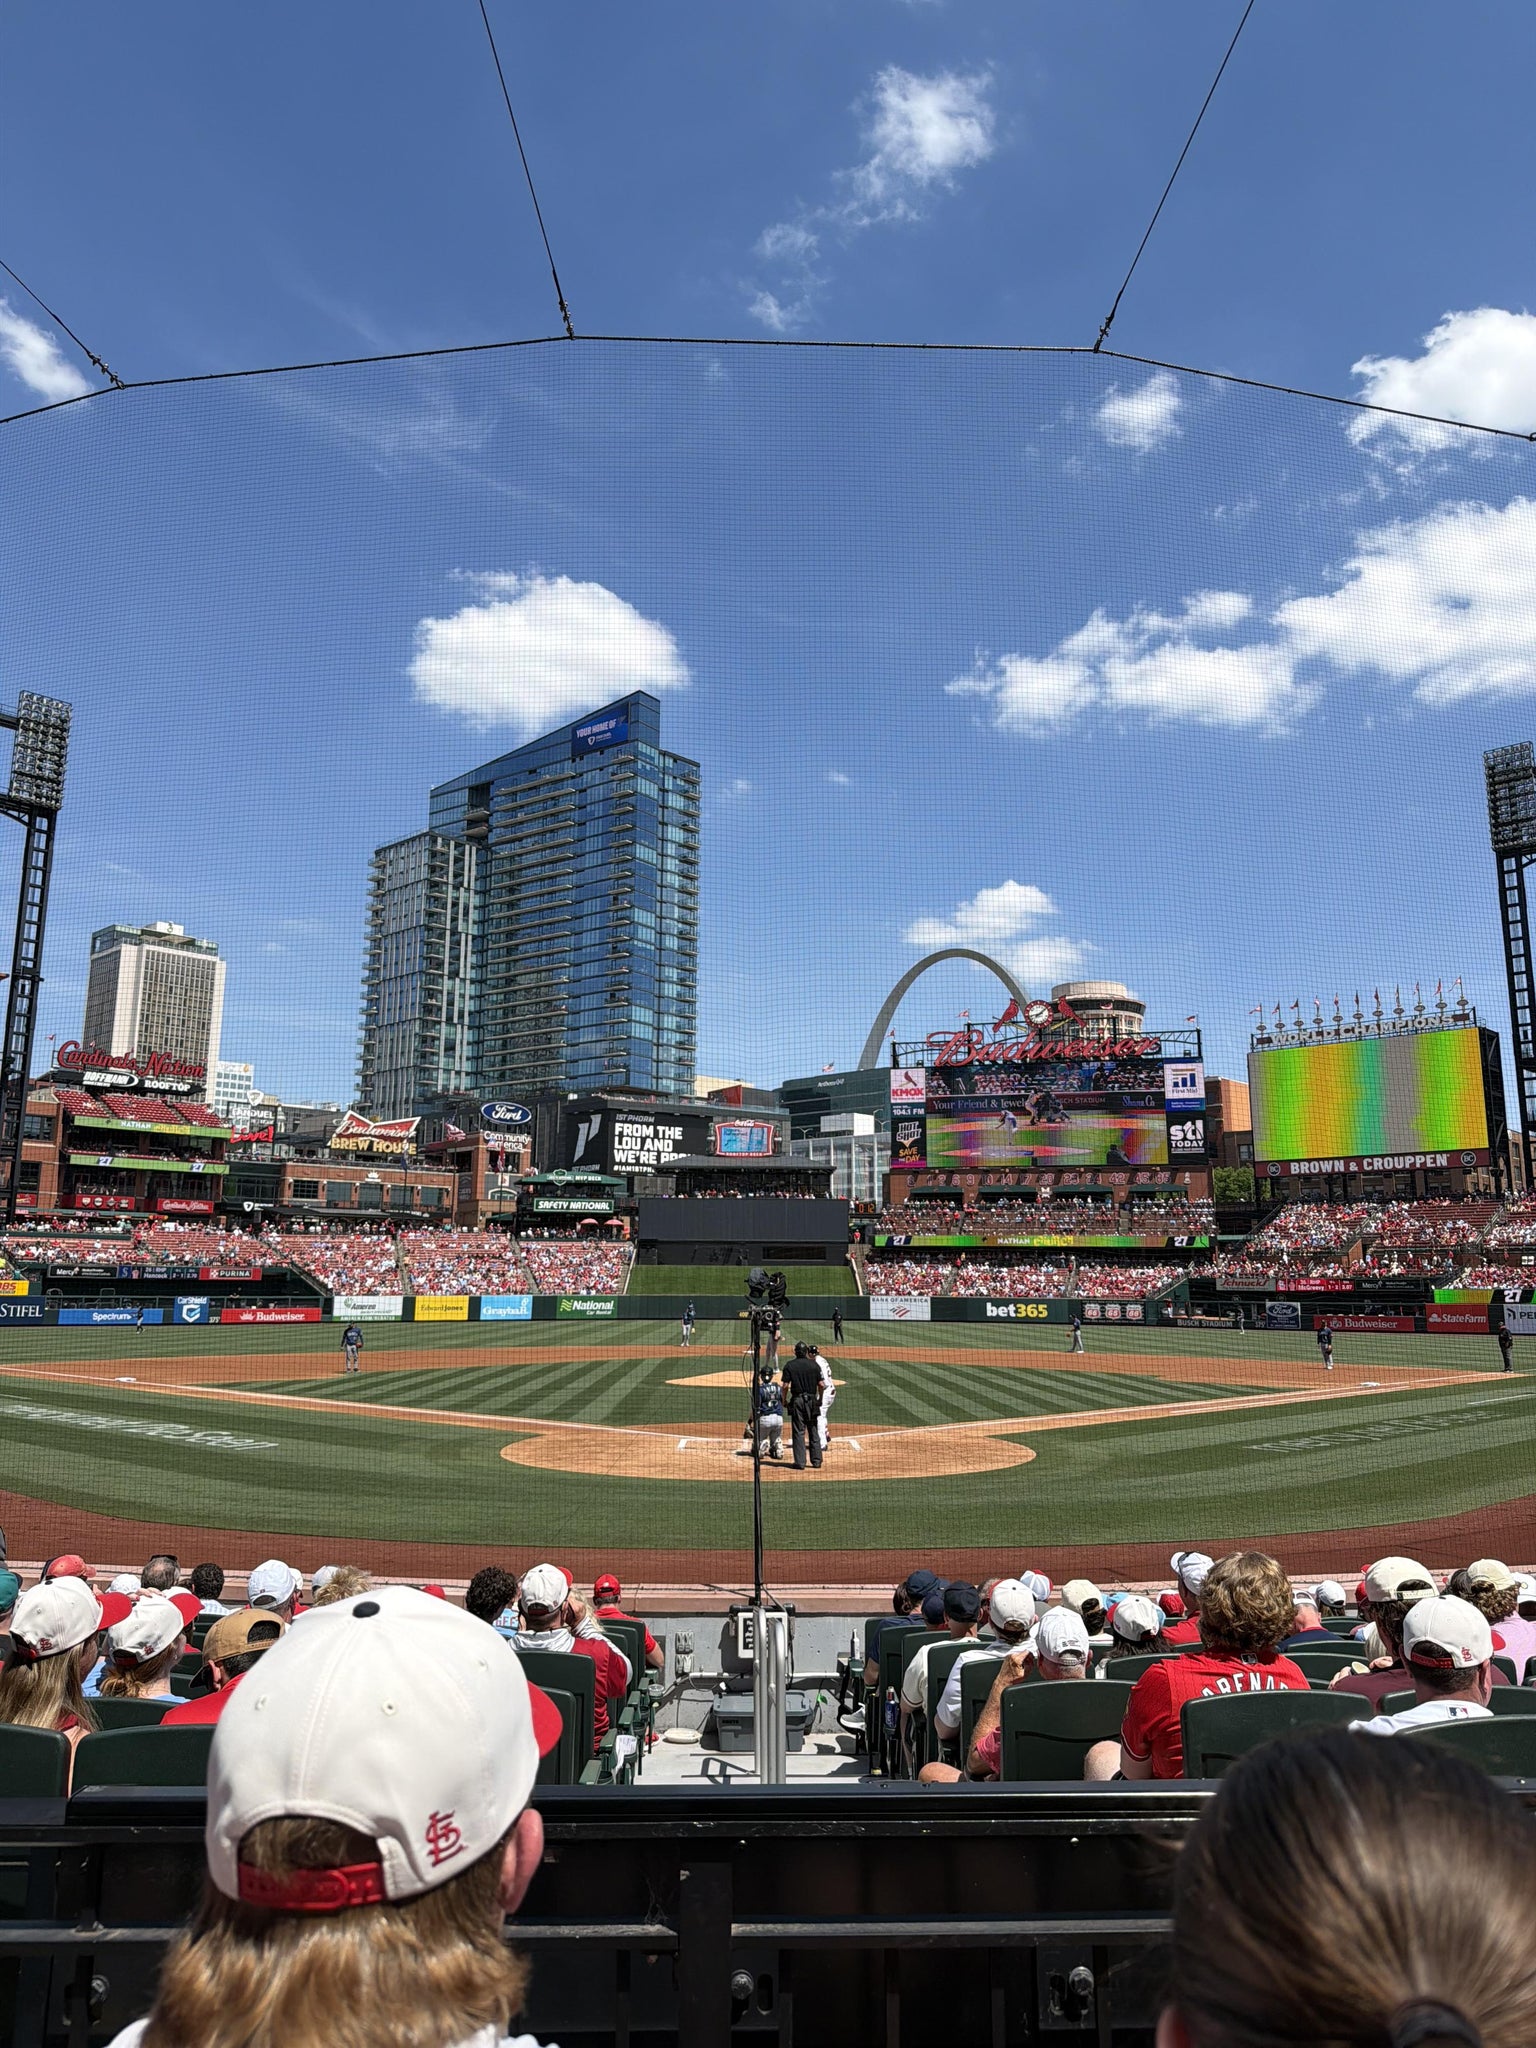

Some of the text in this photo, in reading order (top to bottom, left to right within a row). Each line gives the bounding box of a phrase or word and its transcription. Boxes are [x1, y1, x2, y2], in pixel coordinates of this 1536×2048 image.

[576, 727, 591, 738] YOUR
[1269, 1015, 1454, 1045] WORLD CHAMPIONS
[925, 1029, 1161, 1067] Budweiser
[57, 1040, 204, 1078] Cardinals Nation
[83, 1071, 130, 1085] HOFFMANN
[144, 1080, 191, 1092] ROOFTOP
[892, 1087, 924, 1097] KMOX
[933, 1101, 957, 1111] Your
[957, 1100, 989, 1109] Friend
[990, 1099, 998, 1109] &
[492, 1104, 522, 1120] Ford
[627, 1114, 655, 1123] PHORM
[121, 1120, 151, 1129] NATHAN
[332, 1118, 417, 1138] Budweiser
[898, 1121, 919, 1132] HOT
[1170, 1120, 1204, 1140] stl
[229, 1125, 275, 1144] Live!
[615, 1122, 683, 1140] FROM THE
[896, 1129, 922, 1141] SHOT
[331, 1137, 371, 1151] BREW
[614, 1136, 673, 1152] LOU AND
[614, 1149, 657, 1164] WE'RE
[899, 1147, 918, 1157] SAVE
[99, 1156, 113, 1166] 27
[905, 1154, 920, 1163] DAY
[1290, 1160, 1345, 1174] BROWN
[1349, 1161, 1359, 1172] &
[1363, 1154, 1448, 1171] CROUPPEN
[192, 1163, 205, 1172] 27
[966, 1174, 975, 1185] 9
[1000, 1173, 1013, 1185] 14
[1063, 1173, 1080, 1185] 23
[1109, 1172, 1126, 1185] 42
[1135, 1172, 1151, 1184] 45
[538, 1201, 610, 1210] SAFETY NATIONAL
[892, 1236, 906, 1246] 27
[997, 1237, 1030, 1245] NATHAN
[1174, 1236, 1188, 1246] 27
[56, 1267, 75, 1276] Mercy
[1222, 1278, 1269, 1287] Schnucks
[1362, 1281, 1379, 1289] Mercy
[177, 1296, 208, 1304] CarShield
[1503, 1289, 1522, 1303] 27
[0, 1303, 43, 1317] STIFEL
[572, 1300, 614, 1310] National
[986, 1302, 1048, 1318] bet365
[1272, 1304, 1293, 1314] Ford
[92, 1312, 128, 1321] Spectrum
[256, 1311, 305, 1321] Budweiser
[1086, 1308, 1100, 1316] 66
[1177, 1318, 1199, 1327] BUSCH
[1345, 1317, 1398, 1329] Budweiser
